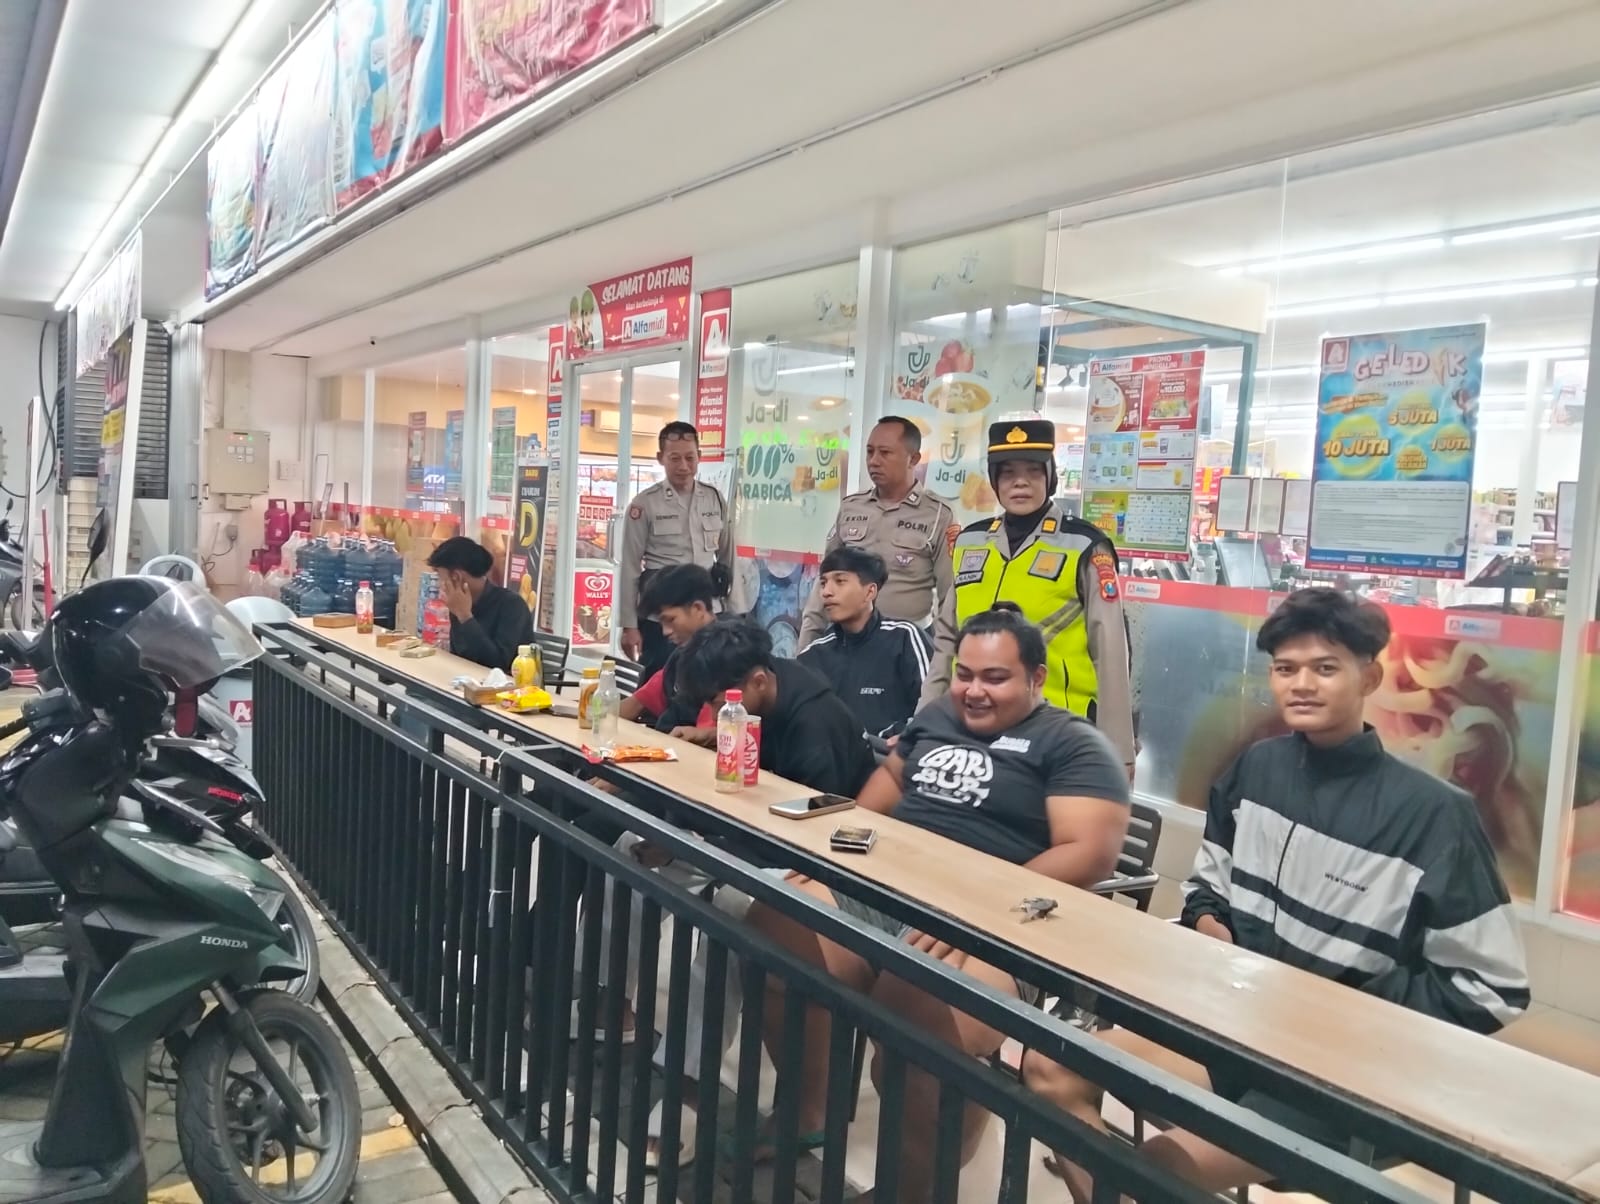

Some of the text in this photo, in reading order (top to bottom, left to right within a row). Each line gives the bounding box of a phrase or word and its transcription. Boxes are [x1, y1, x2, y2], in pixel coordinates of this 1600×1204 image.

[602, 265, 690, 306] SELAMAT DATANG
[633, 316, 665, 335] Alfamidi
[746, 398, 789, 424] Ja-di
[1400, 408, 1439, 425] JUTA
[1323, 439, 1391, 457] 10 JUTA
[815, 466, 838, 481] Ja-di
[935, 468, 967, 483] Ja-di
[897, 520, 928, 533] POLRI
[200, 935, 249, 949] HONDA
